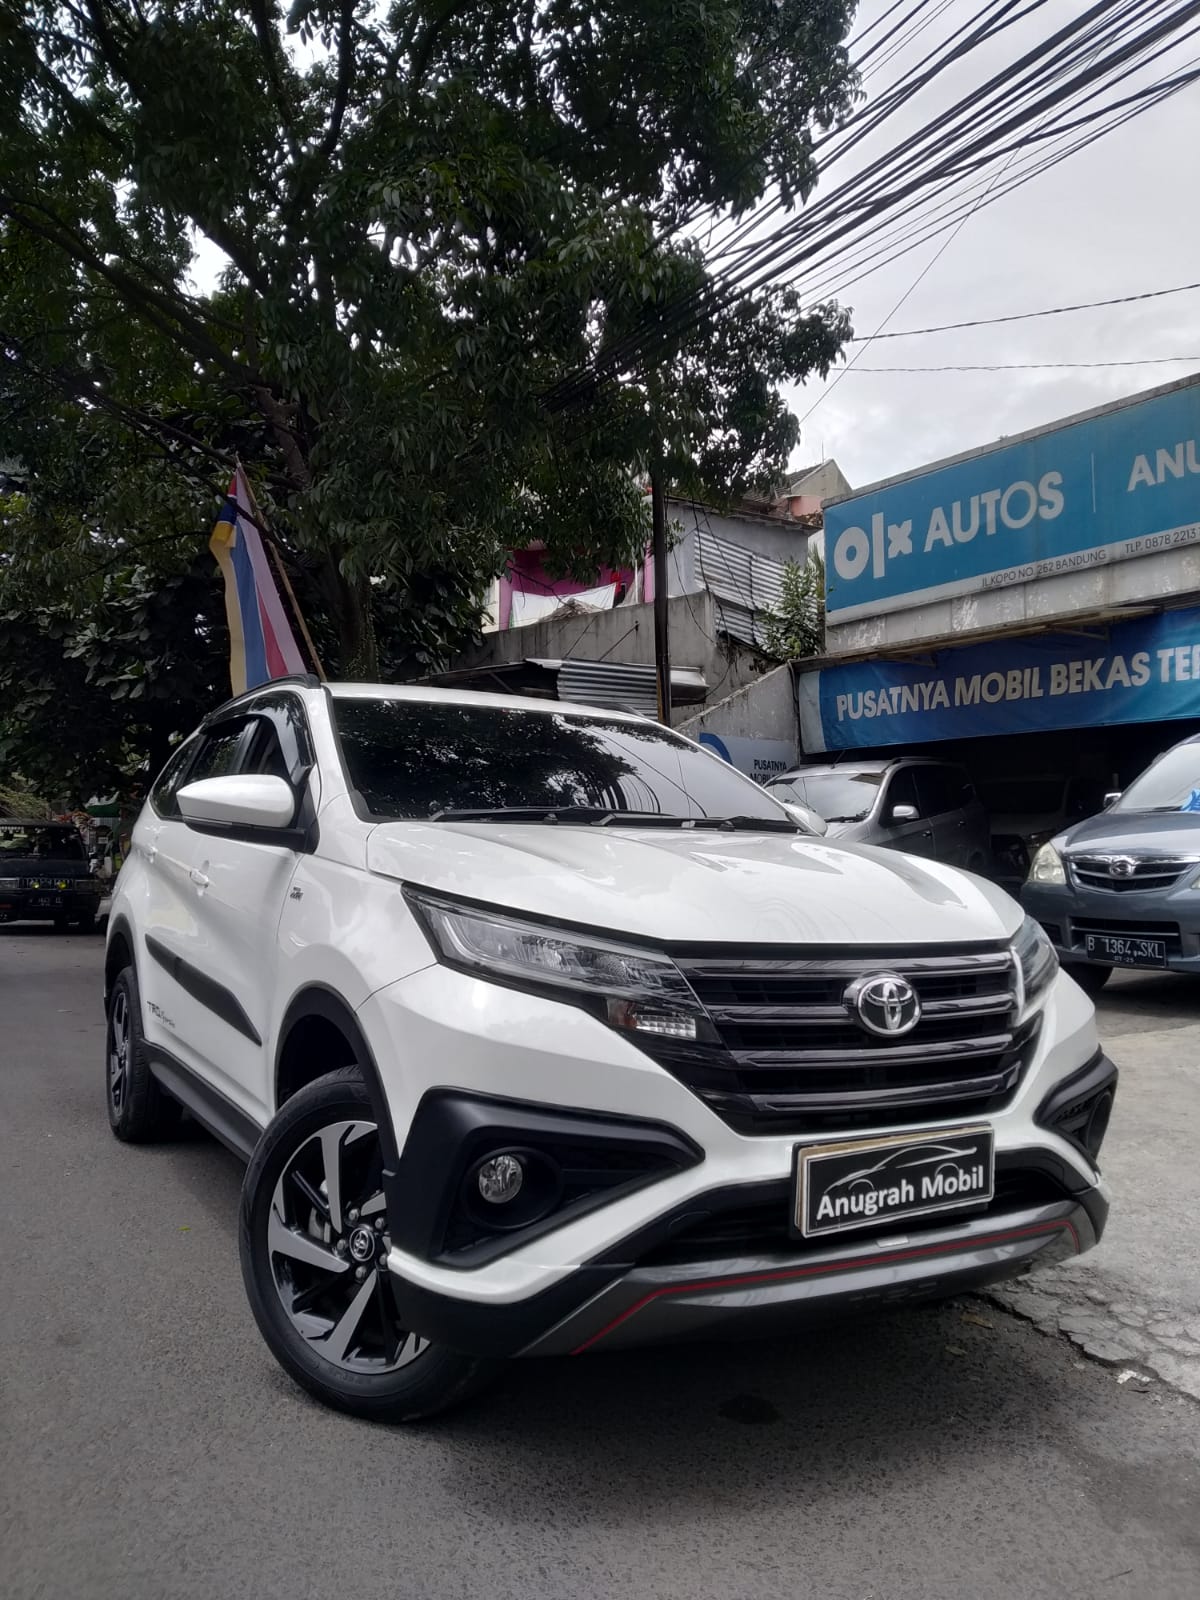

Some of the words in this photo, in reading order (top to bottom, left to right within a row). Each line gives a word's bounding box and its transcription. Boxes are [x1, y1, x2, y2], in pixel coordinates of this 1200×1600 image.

[924, 472, 1064, 552] AUTOS
[1055, 549, 1107, 570] BANDUNG
[836, 680, 951, 722] PUSATNYA
[954, 665, 1044, 706] MOBIL
[1049, 651, 1151, 696] BEKAS
[753, 759, 787, 771] PUSATNYA
[1087, 936, 1095, 951] B
[1104, 938, 1132, 955] 1364
[1140, 942, 1163, 959] SKL
[816, 1179, 914, 1221] Anugrah
[921, 1165, 984, 1199] Mobil
